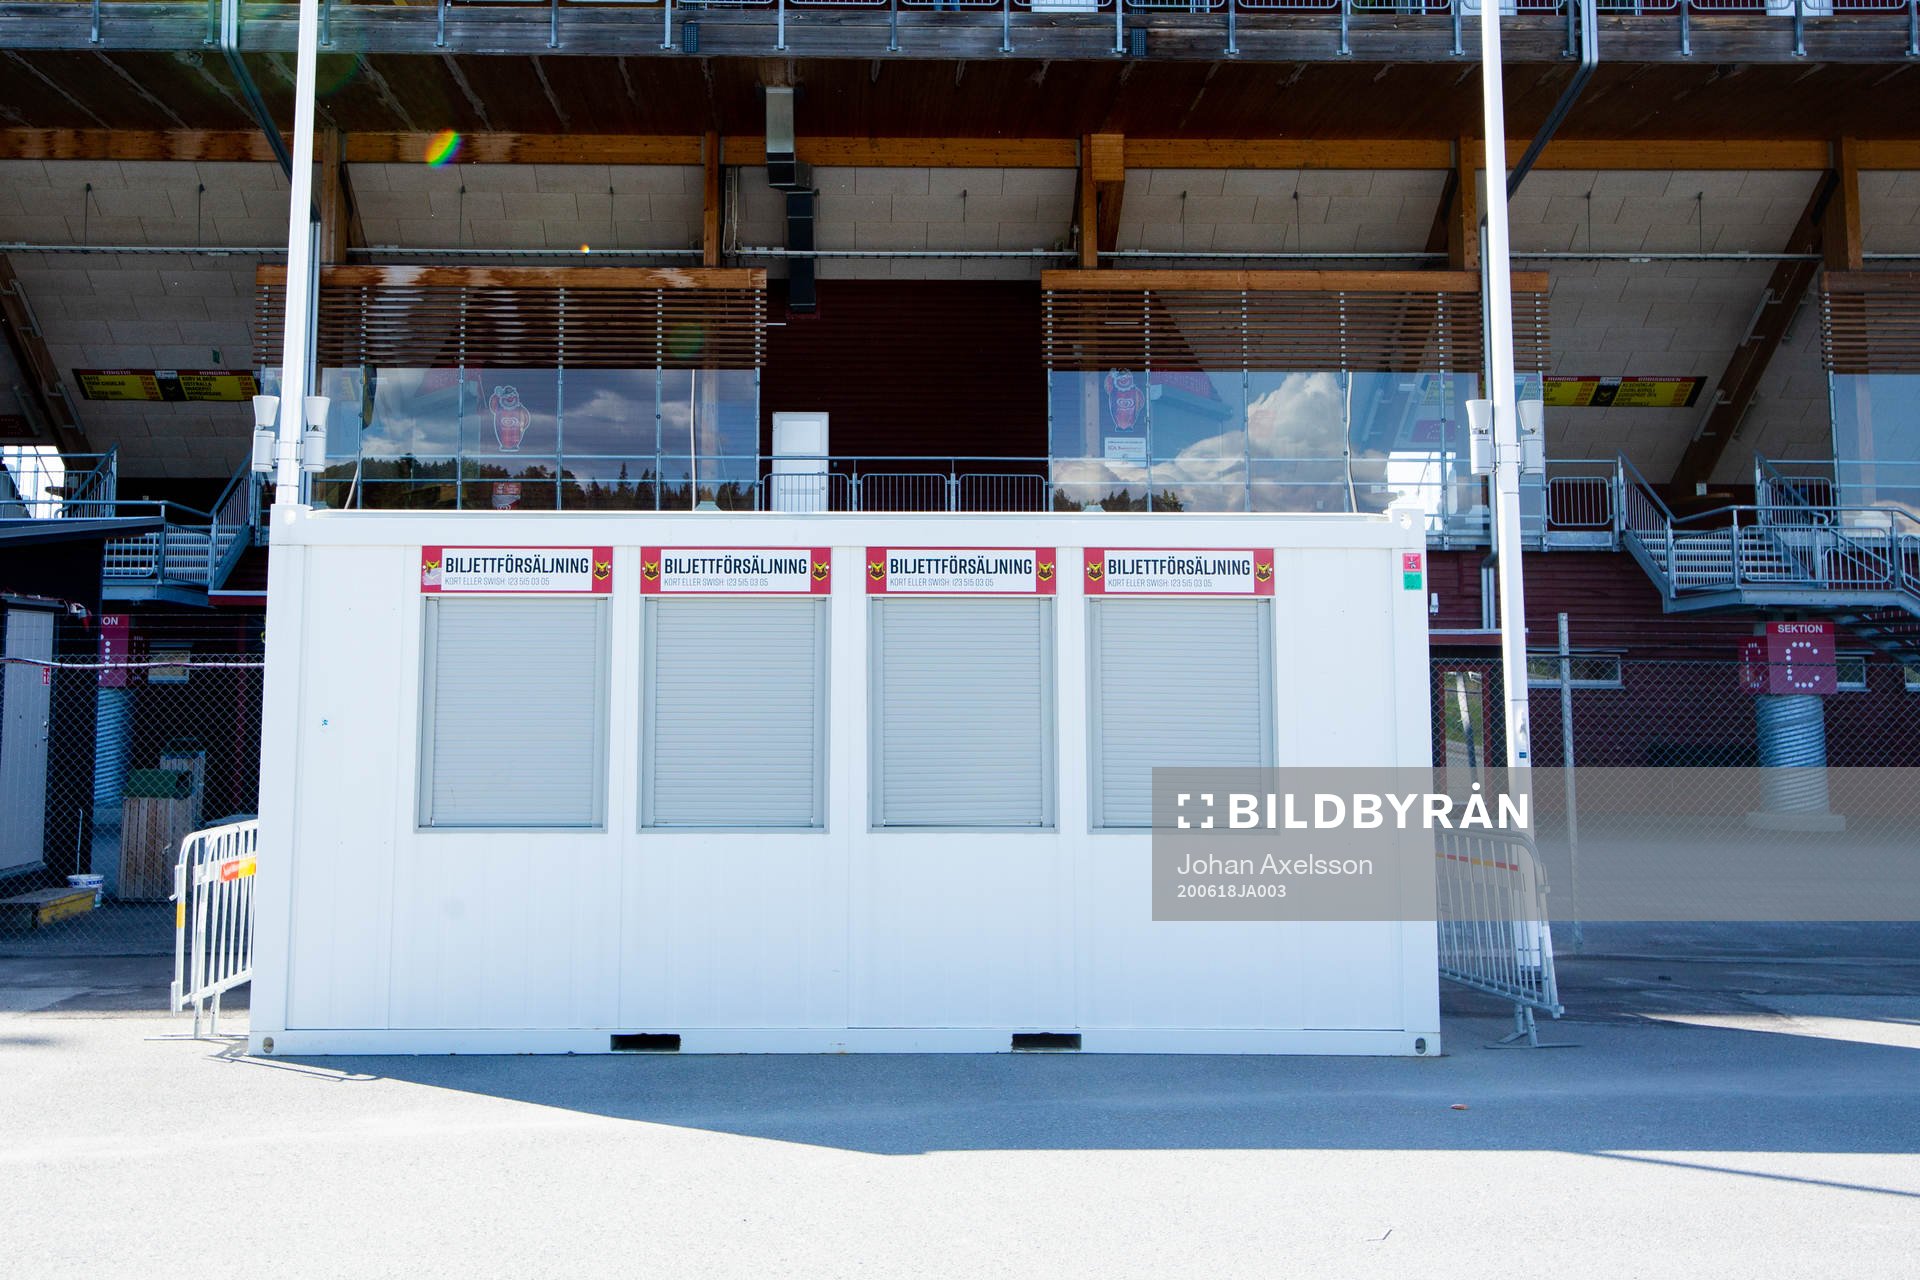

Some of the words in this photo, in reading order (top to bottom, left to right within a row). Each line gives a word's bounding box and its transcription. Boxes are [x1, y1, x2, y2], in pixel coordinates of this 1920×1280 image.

[445, 554, 589, 574] BILJETTFÖRSÄLJNING
[664, 555, 808, 575] BILJETTFÖRSÄLJNING
[890, 555, 1033, 575] BILJETTFÖRSÄLJNING
[1108, 556, 1251, 576] BILJETTFÖRSÄLJNING
[444, 577, 461, 586] KORT
[463, 577, 482, 586] ELLER
[507, 577, 518, 586] 123
[531, 577, 540, 586] 03
[664, 577, 680, 587] KORT
[682, 577, 701, 587] ELLER
[726, 577, 737, 587] 123
[749, 577, 759, 587] 03
[890, 578, 906, 587] KORT
[908, 578, 927, 587] ELLER
[952, 578, 962, 587] 123
[975, 578, 984, 587] 03
[1108, 578, 1124, 588] KORT
[1126, 578, 1145, 588] ELLER
[1171, 578, 1181, 588] 123
[1193, 578, 1203, 588] 03
[1777, 624, 1823, 633] SEKTION
[1785, 641, 1820, 689] C
